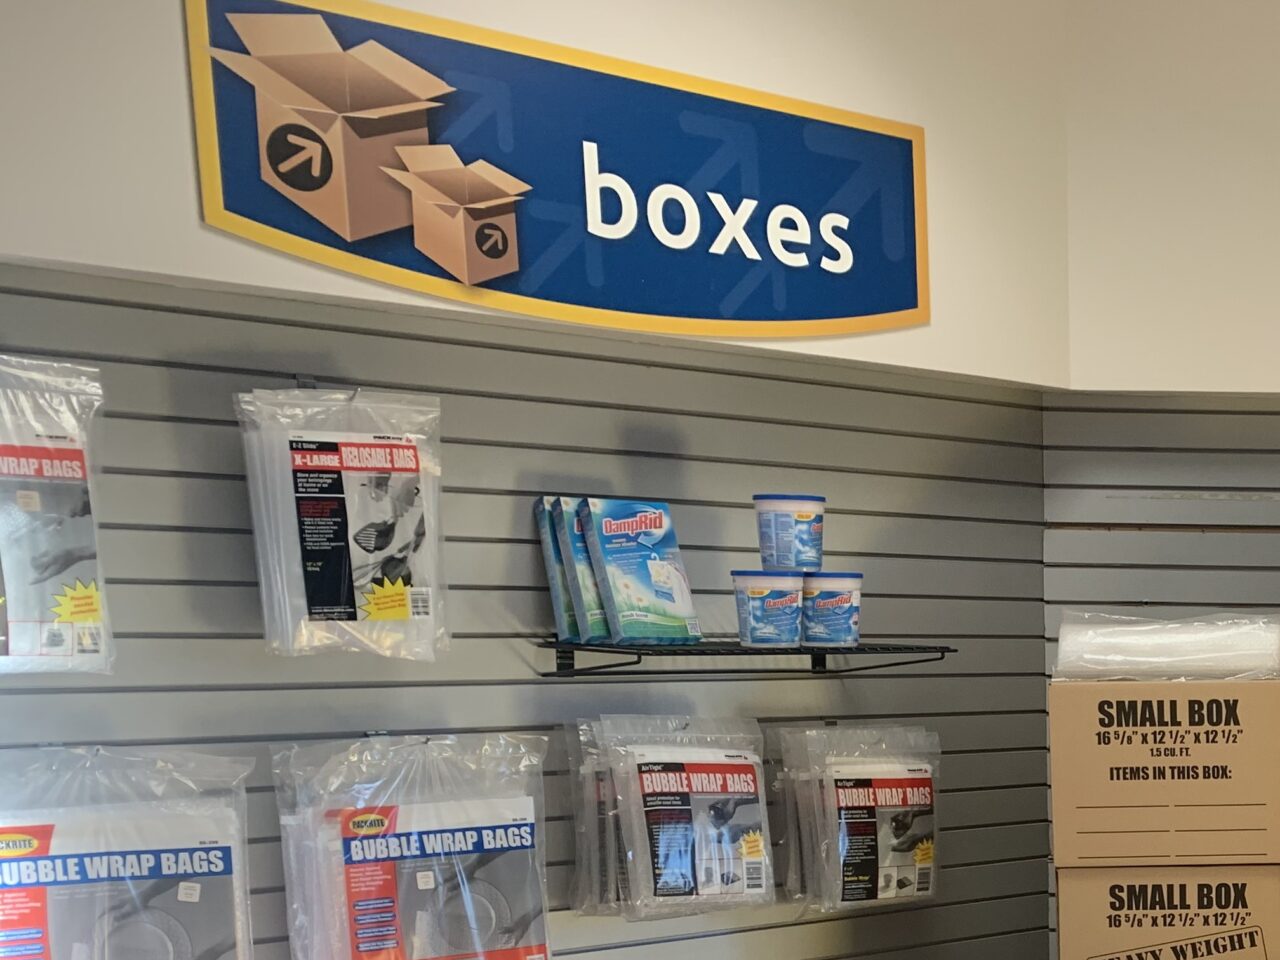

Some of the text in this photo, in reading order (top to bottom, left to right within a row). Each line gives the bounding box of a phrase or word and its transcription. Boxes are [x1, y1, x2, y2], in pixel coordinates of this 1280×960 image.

[581, 140, 855, 274] boxes
[43, 460, 83, 478] BAGS
[293, 454, 341, 466] X-LARGE
[392, 448, 416, 469] BAGS
[603, 510, 664, 536] DampRid
[1098, 699, 1240, 727] SMALL BOX
[642, 772, 755, 793] BUBBLE WRAP BAGS
[1109, 765, 1232, 781] ITEMS IN THIS BOX:
[838, 787, 930, 806] BUBBLE WRAP BAGS
[350, 827, 532, 861] BUBBLE WRAP BAGS
[84, 853, 155, 878] WRAP
[161, 850, 224, 874] BAGS
[1109, 883, 1248, 911] SMALL BOX
